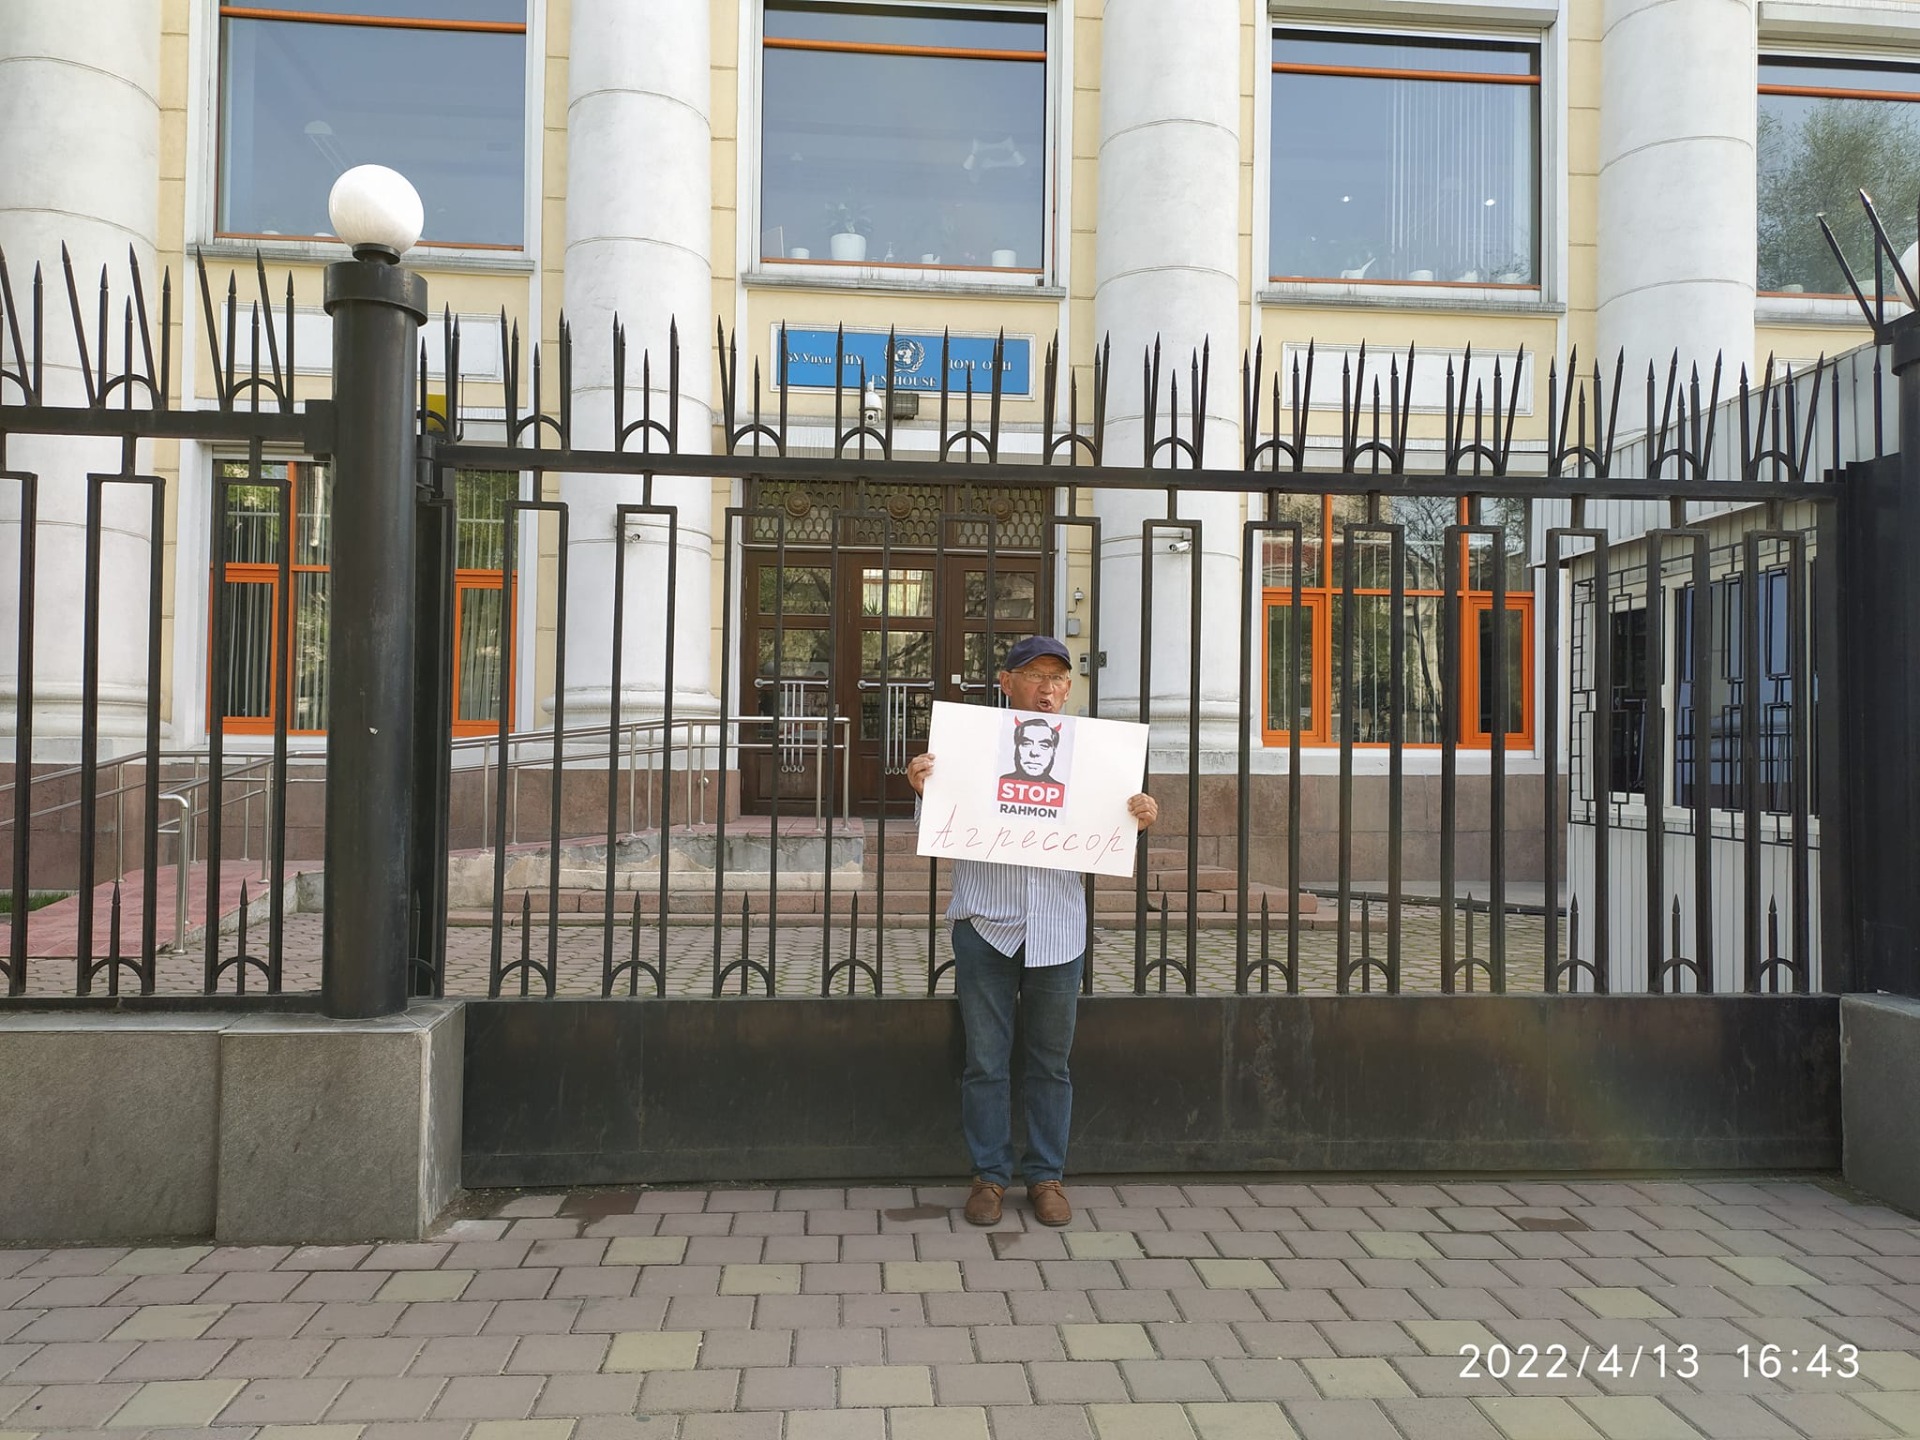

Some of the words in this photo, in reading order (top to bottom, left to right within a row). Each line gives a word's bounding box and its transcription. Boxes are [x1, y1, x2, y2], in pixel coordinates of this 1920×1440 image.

[982, 360, 1012, 371] ОН
[893, 375, 937, 387] HOUSE
[1000, 781, 1061, 804] STOP
[999, 803, 1058, 819] RAHMON
[930, 804, 1125, 865] Агрессор
